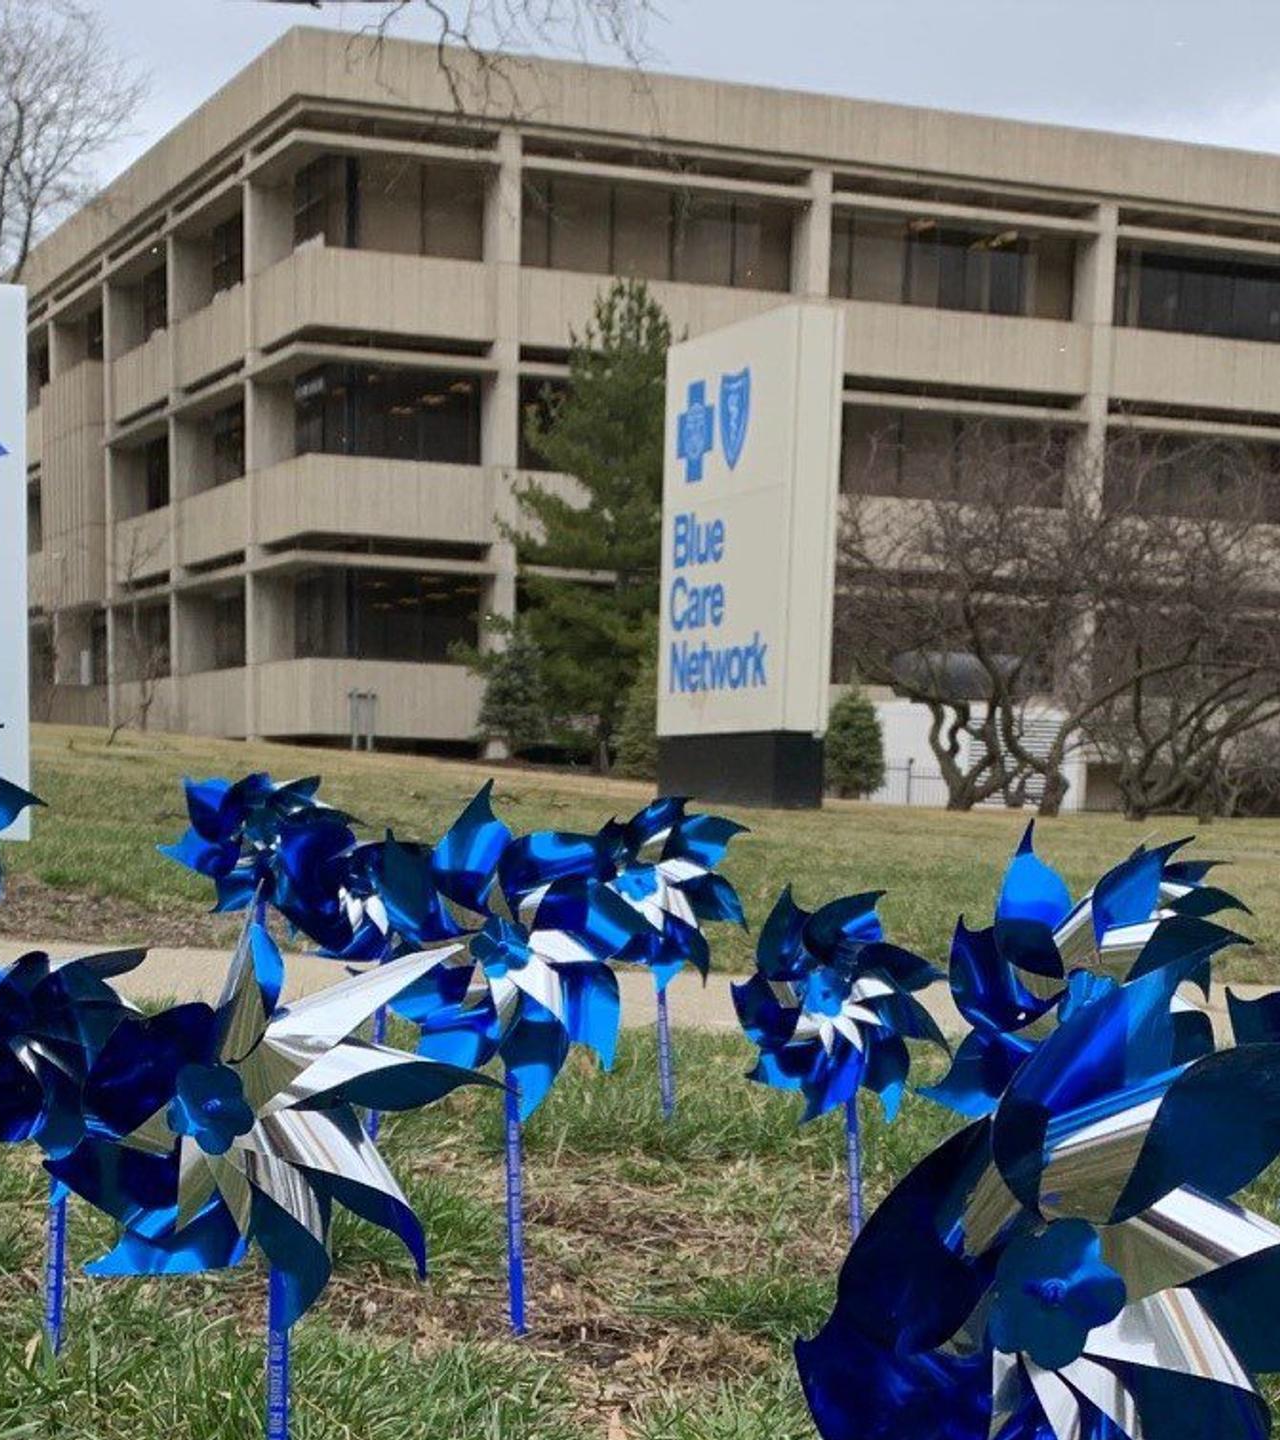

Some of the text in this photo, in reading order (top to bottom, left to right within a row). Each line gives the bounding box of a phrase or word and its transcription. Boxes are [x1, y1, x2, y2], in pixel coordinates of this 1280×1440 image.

[674, 513, 724, 568] Blue
[671, 576, 724, 631] Care
[670, 631, 767, 693] Network
